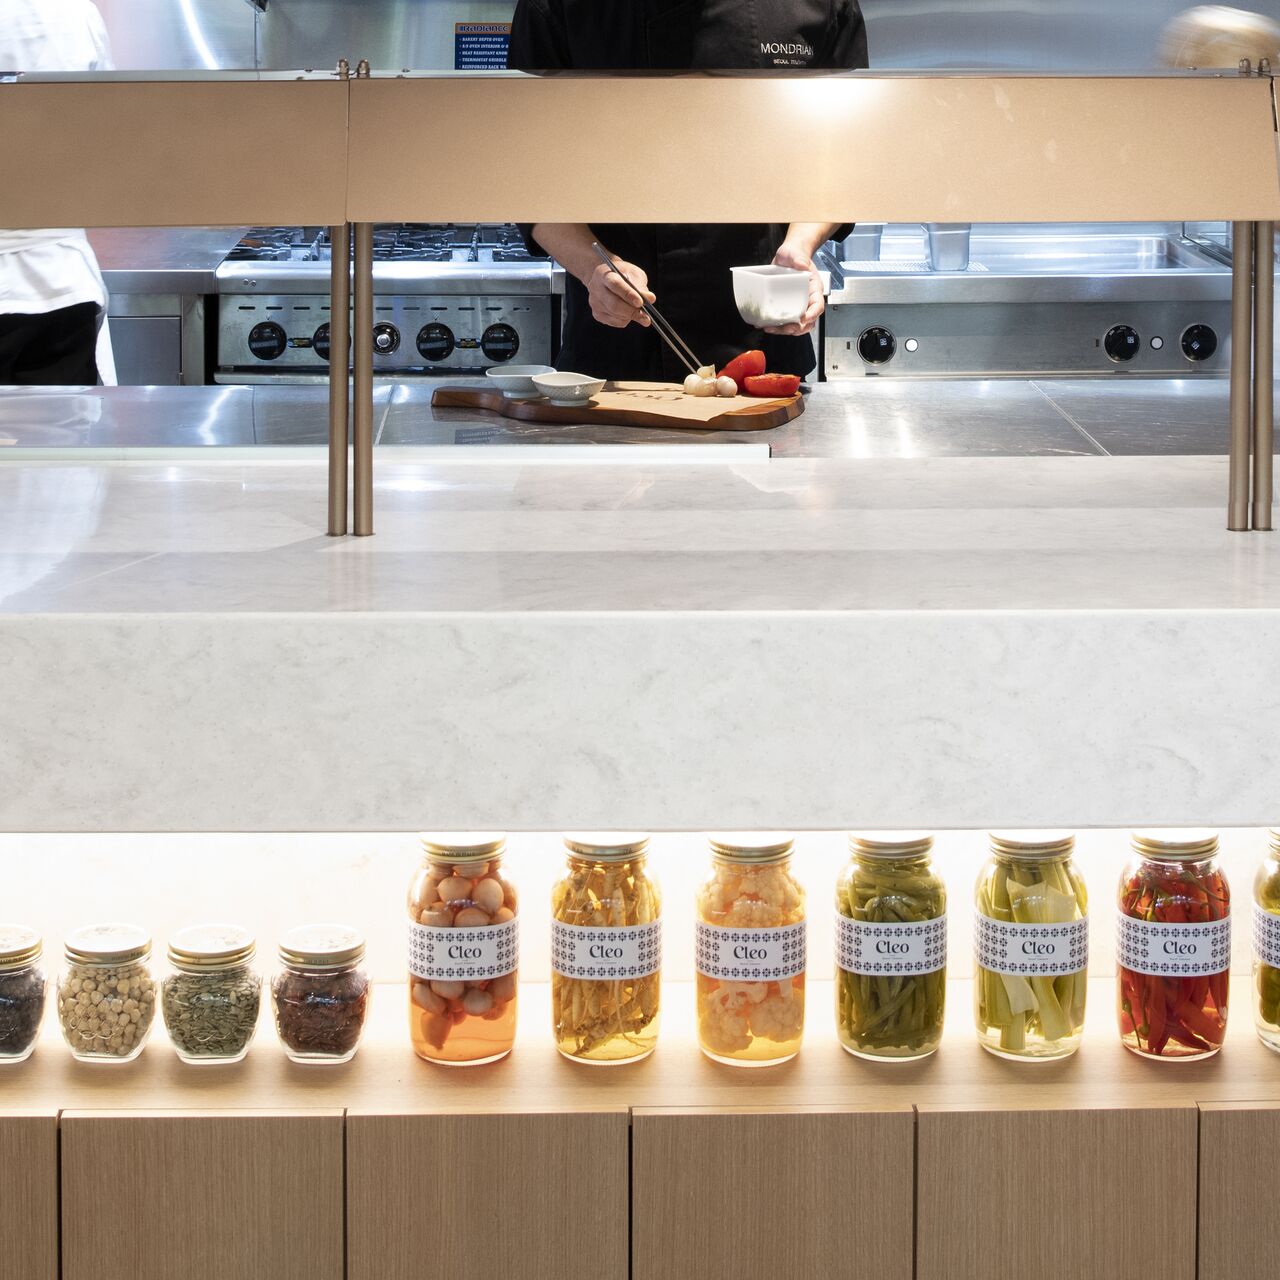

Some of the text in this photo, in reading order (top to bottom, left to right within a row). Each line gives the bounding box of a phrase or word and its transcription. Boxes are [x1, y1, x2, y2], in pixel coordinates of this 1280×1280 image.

[760, 42, 813, 56] MONDRIAN
[447, 945, 482, 959] Cleo
[589, 944, 624, 959] Cleo
[733, 945, 768, 960] Cleo
[875, 940, 910, 954] Cleo
[1021, 940, 1056, 955] Cleo
[1162, 940, 1197, 955] Cleo
